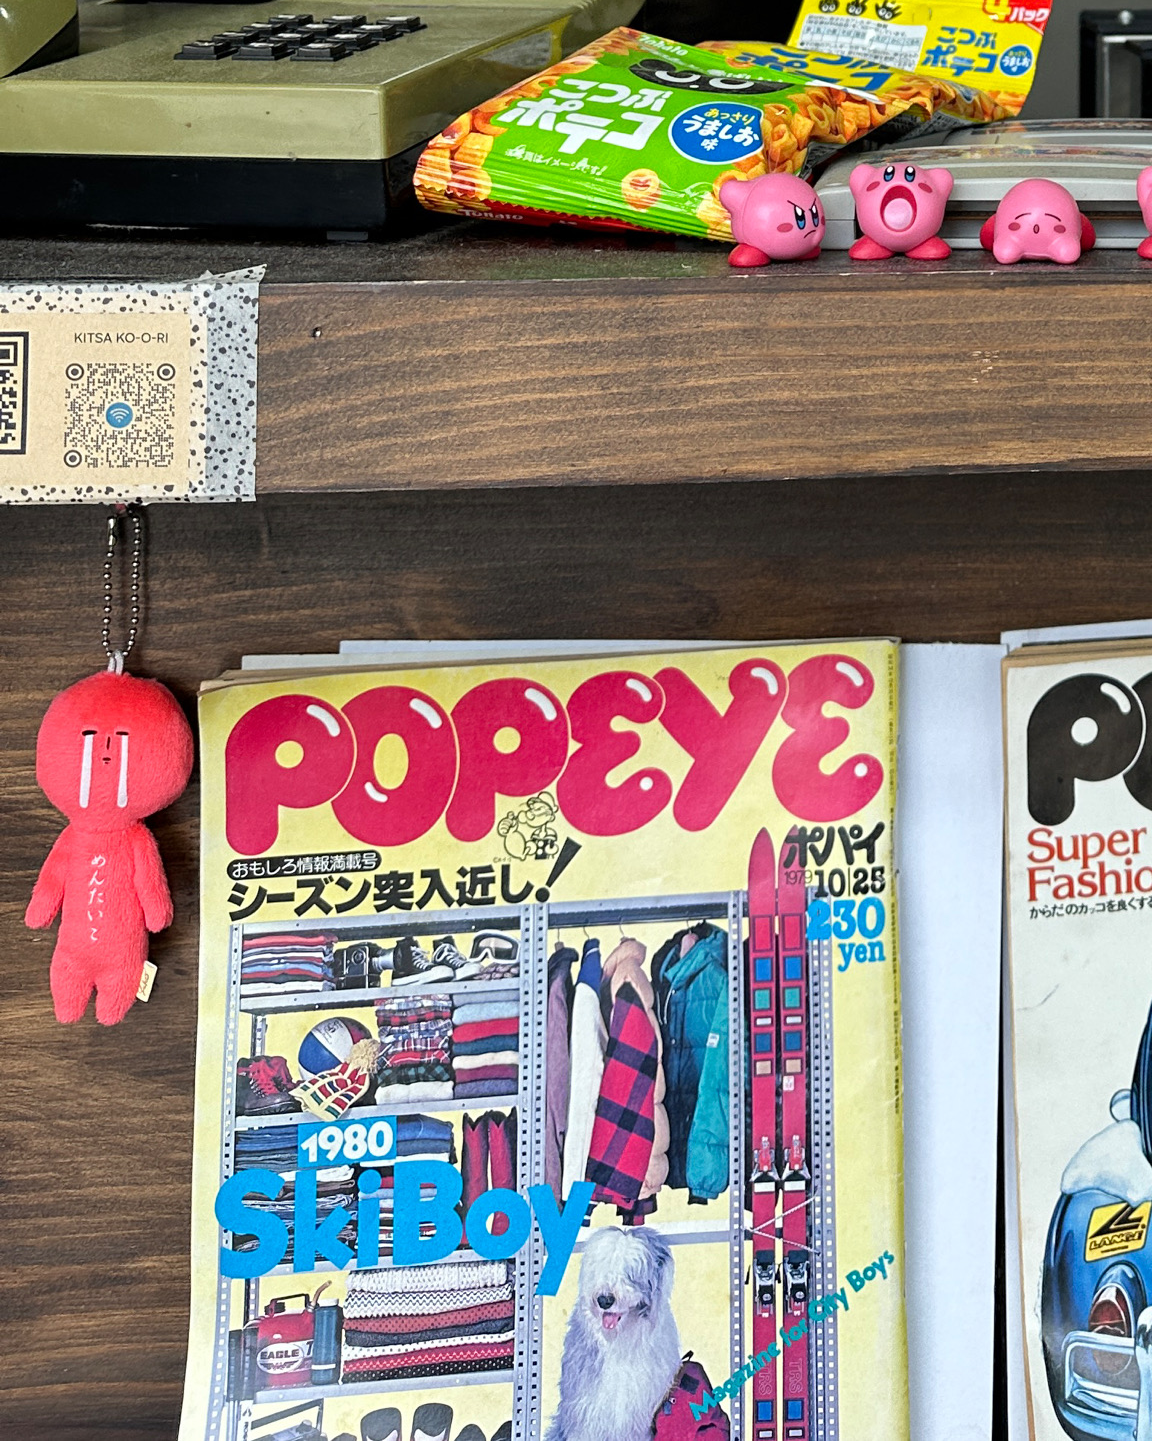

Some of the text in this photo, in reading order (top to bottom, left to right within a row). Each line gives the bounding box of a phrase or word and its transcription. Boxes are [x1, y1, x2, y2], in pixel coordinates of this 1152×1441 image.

[937, 26, 997, 49] こつぶ
[922, 44, 999, 77] ポテコ
[550, 78, 674, 112] こつぶ
[496, 98, 666, 155] ポテコ
[683, 115, 760, 147] うましお
[704, 108, 756, 126] あっさり
[701, 137, 719, 151] 味
[74, 332, 169, 344] KITSA KO-O-RI
[226, 653, 884, 856] POPEYE
[783, 821, 886, 869] ポパイ
[1027, 826, 1148, 870] Super
[231, 851, 378, 878] おもしろ情報満載号
[88, 853, 107, 942] めんたいこ
[806, 896, 886, 941] 230
[837, 940, 887, 973] yen
[300, 1121, 395, 1163] 1980
[688, 1249, 896, 1422] Magazine for City Boys
[259, 1348, 300, 1360] EAGLE
